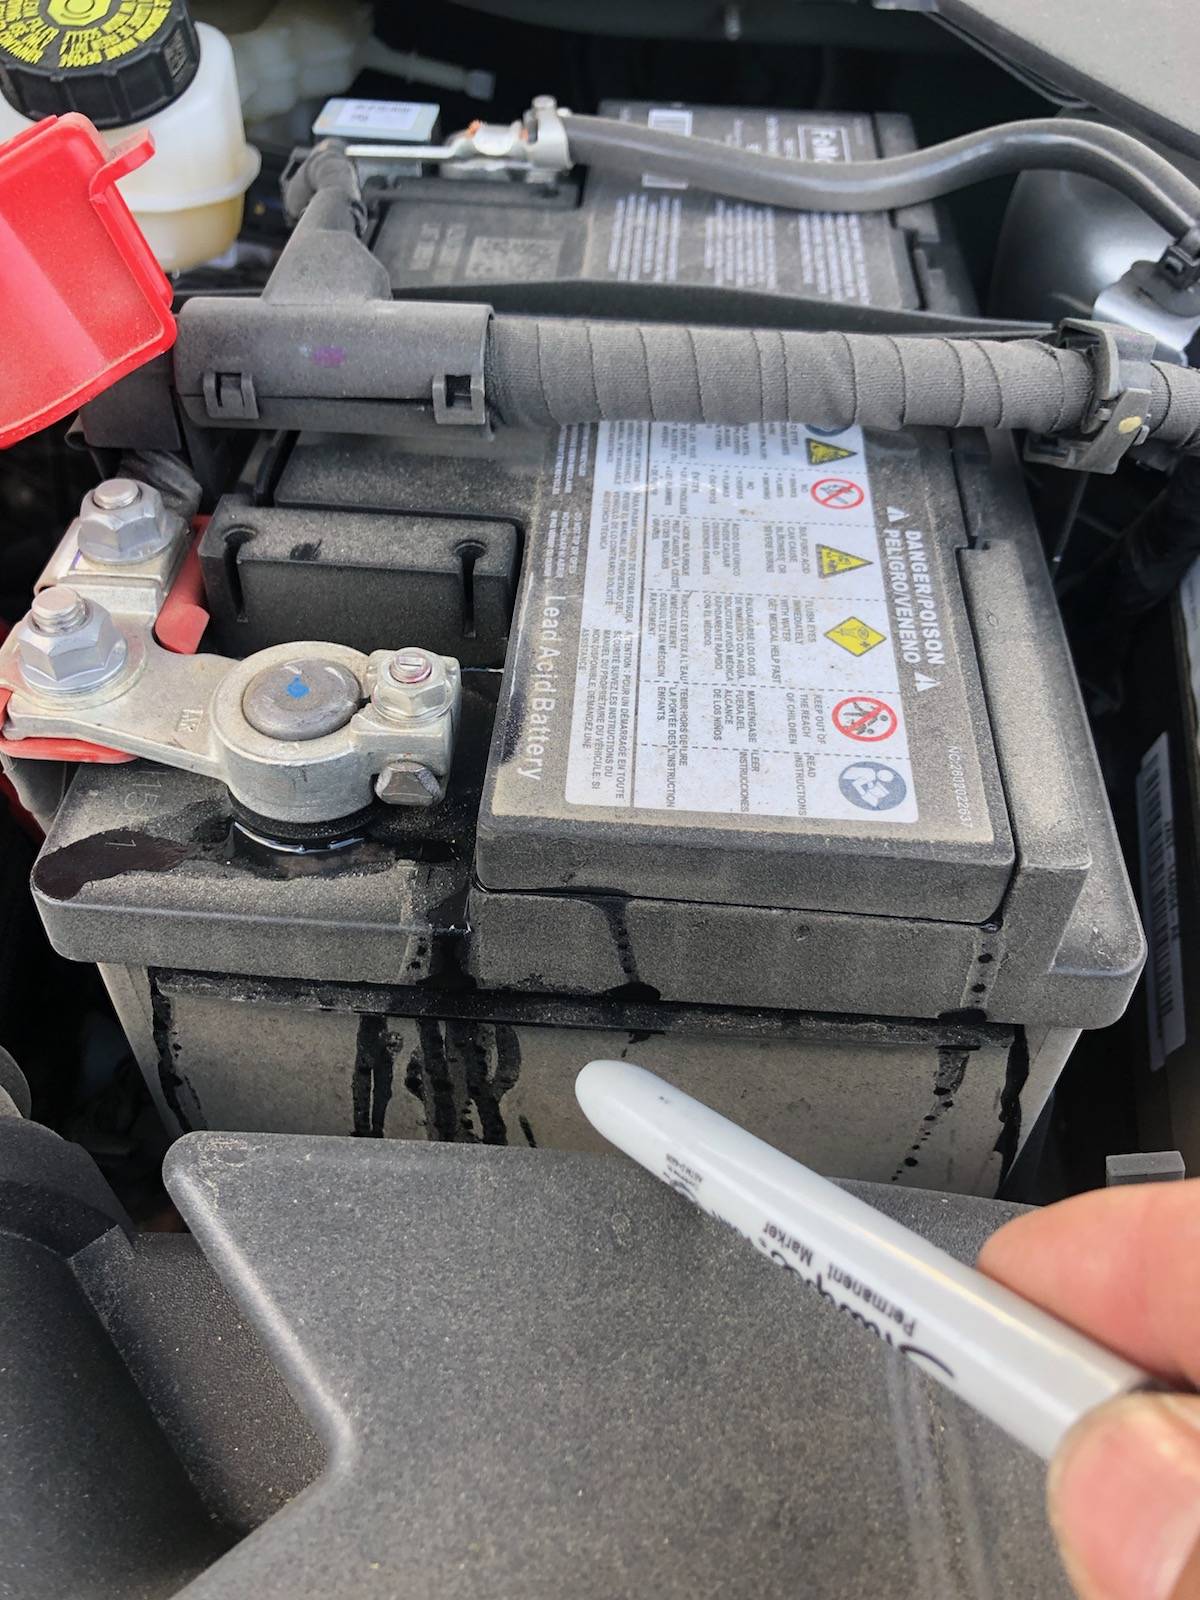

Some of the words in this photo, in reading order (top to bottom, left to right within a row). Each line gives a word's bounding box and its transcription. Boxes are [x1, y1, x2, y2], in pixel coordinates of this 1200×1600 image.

[735, 596, 743, 606] DE
[768, 598, 777, 612] GET
[884, 529, 920, 664] PELIGRO/VENENO
[905, 531, 945, 664] DANGER/POISON
[542, 595, 566, 641] Lead
[659, 593, 667, 633] CONSULTEZ
[781, 599, 790, 617] WITH
[591, 628, 600, 645] NON
[769, 613, 780, 644] MEDICAL
[781, 618, 790, 642] WATER
[807, 624, 816, 643] EYES
[658, 634, 666, 644] UN
[680, 633, 688, 653] YEUX
[725, 631, 733, 654] AYUDA
[747, 642, 755, 656] LOS
[601, 659, 609, 669] DU
[658, 645, 667, 677] MÉDECIN
[771, 645, 780, 664] HELP
[534, 646, 561, 692] Acid
[726, 655, 734, 682] MÉDICA
[747, 657, 755, 676] OJOS
[772, 665, 782, 684] FAST
[611, 666, 620, 691] SUIVEZ
[622, 675, 631, 695] POUR
[609, 692, 619, 705] LES
[620, 697, 630, 707] UN
[713, 689, 721, 699] DE
[735, 690, 744, 715] FUERA
[786, 692, 795, 704] OF
[799, 693, 809, 709] THE
[586, 690, 598, 731] DEMANDEZ
[668, 698, 677, 729] PORTÉE
[713, 700, 721, 715] LOS
[724, 689, 733, 725] ALCANCE
[813, 694, 824, 715] KEEP
[595, 725, 604, 735] DU
[618, 708, 630, 756] DÉMARRAGE
[680, 711, 688, 733] HORS
[713, 716, 723, 741] NIÑOS
[736, 716, 745, 731] DEL
[787, 704, 797, 744] CHILDREN
[800, 710, 811, 737] REACH
[815, 716, 825, 732] OUT
[516, 698, 556, 781] Battery
[582, 733, 593, 749] UNE
[605, 707, 616, 764] INSTRUCTIONS
[668, 730, 676, 745] DES
[680, 734, 688, 745] DE
[817, 733, 826, 744] OF
[618, 759, 627, 770] EN
[679, 749, 688, 766] LIRE
[751, 752, 760, 772] LEER
[806, 755, 816, 778] READ
[604, 766, 614, 777] DU
[666, 748, 677, 808] L'INSTRUCTION
[616, 772, 625, 798] TOUTE
[739, 752, 749, 812] INSTRUCCIONES
[794, 755, 806, 815] INSTRUCTIONS
[763, 1221, 813, 1266] Marker
[828, 1263, 917, 1337] Permanent
